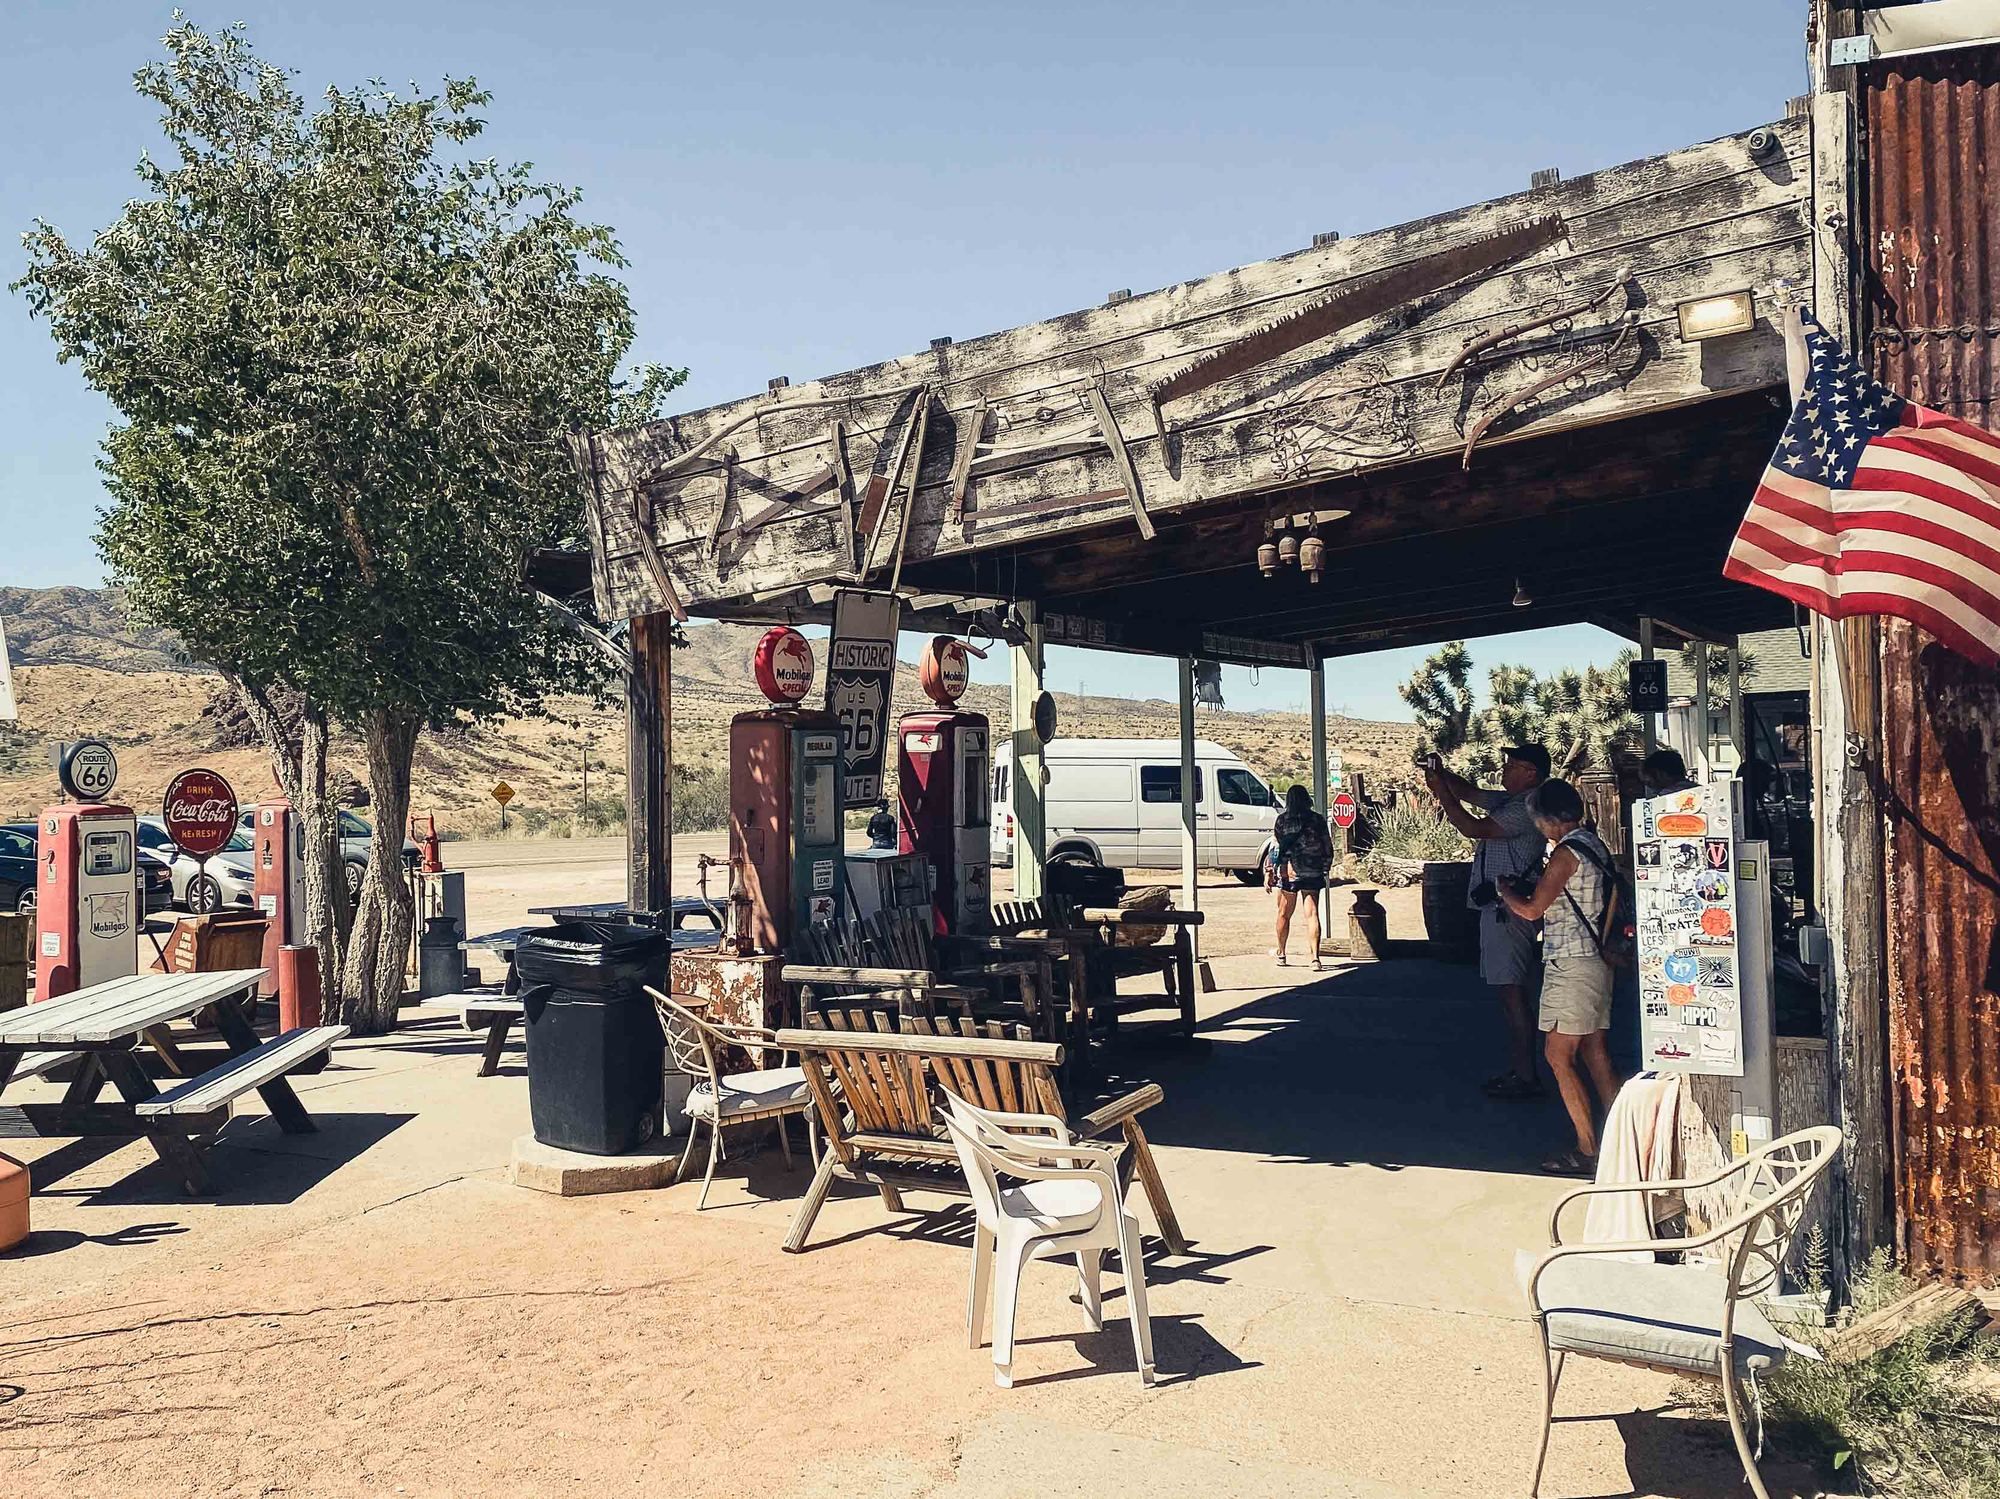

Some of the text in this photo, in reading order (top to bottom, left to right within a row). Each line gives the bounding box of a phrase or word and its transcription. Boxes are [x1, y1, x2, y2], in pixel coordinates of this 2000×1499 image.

[834, 643, 890, 668] HISTORIC
[1639, 681, 1659, 695] 66
[838, 708, 874, 751] 66
[806, 741, 833, 751] REGULAR
[82, 755, 108, 764] ROUTE
[82, 766, 109, 787] 66
[186, 785, 214, 796] DRINK
[843, 776, 872, 799] UTE
[169, 798, 232, 824] Coca-Cola
[1333, 803, 1354, 817] STOP
[817, 876, 831, 885] LEAD
[93, 920, 128, 934] Mobilgas
[1668, 919, 1701, 932] RATS
[1681, 1005, 1717, 1027] HIPPO
